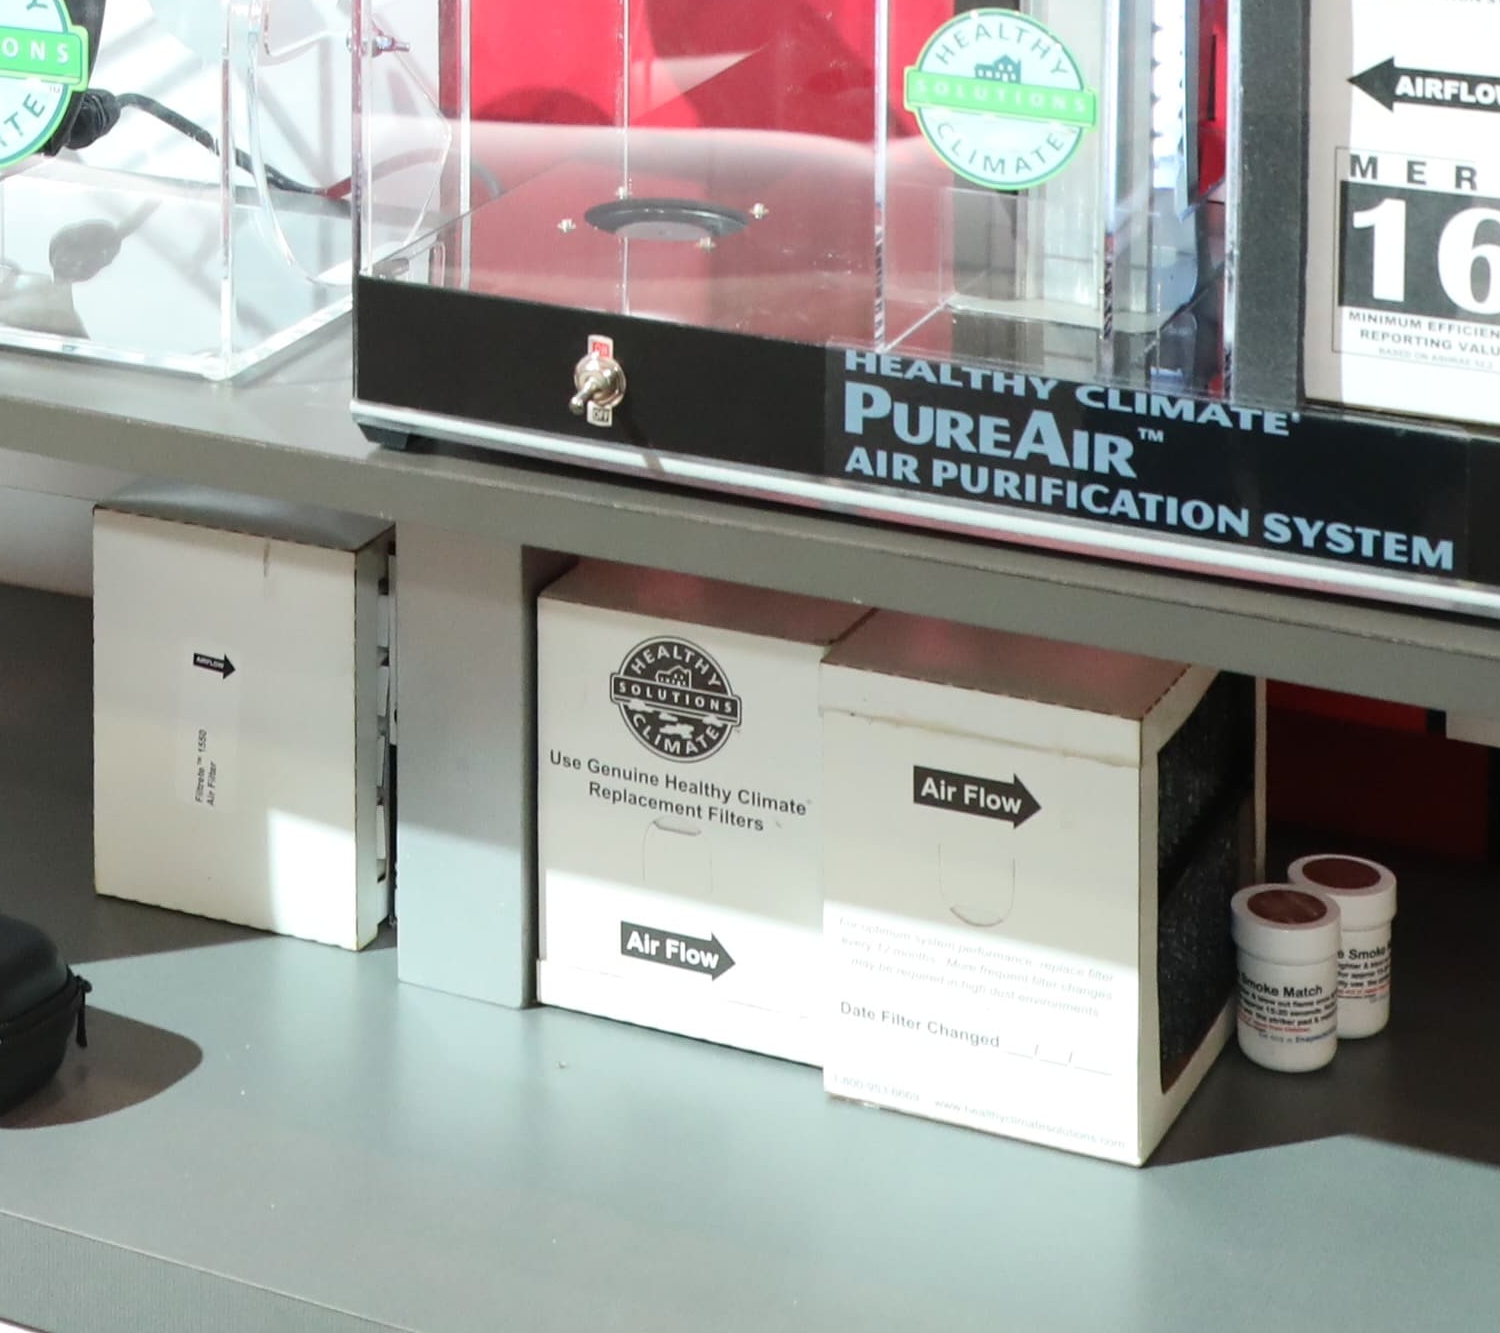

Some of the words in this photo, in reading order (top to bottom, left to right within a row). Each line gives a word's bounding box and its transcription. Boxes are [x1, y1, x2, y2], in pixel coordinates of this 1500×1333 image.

[935, 22, 1069, 75] HEALTHY
[917, 79, 1086, 113] SOLUTIONS
[937, 121, 1065, 175] CLIMATE
[1349, 310, 1422, 330] MINIMUM
[1360, 328, 1453, 351] REPORTING
[845, 349, 1059, 401] HEALTHY
[845, 447, 920, 485] AIR
[932, 461, 1249, 536] PURIFICATION
[1263, 511, 1454, 571] SYSTEM
[630, 645, 722, 686] HEALTHY
[619, 681, 732, 713] SOLUTIONS
[633, 713, 720, 754] CLIMATE
[549, 749, 582, 771] Use
[587, 758, 660, 788] Genuine
[664, 774, 732, 804] Healthy
[920, 776, 957, 803] Air
[963, 784, 1023, 815] Flow
[588, 781, 703, 820] Replacement
[707, 805, 764, 832] Filters
[626, 930, 663, 957] Air
[666, 938, 719, 971] Flow
[839, 1001, 876, 1021] Date
[881, 1010, 921, 1031] Filter
[927, 1020, 1000, 1048] Changed
